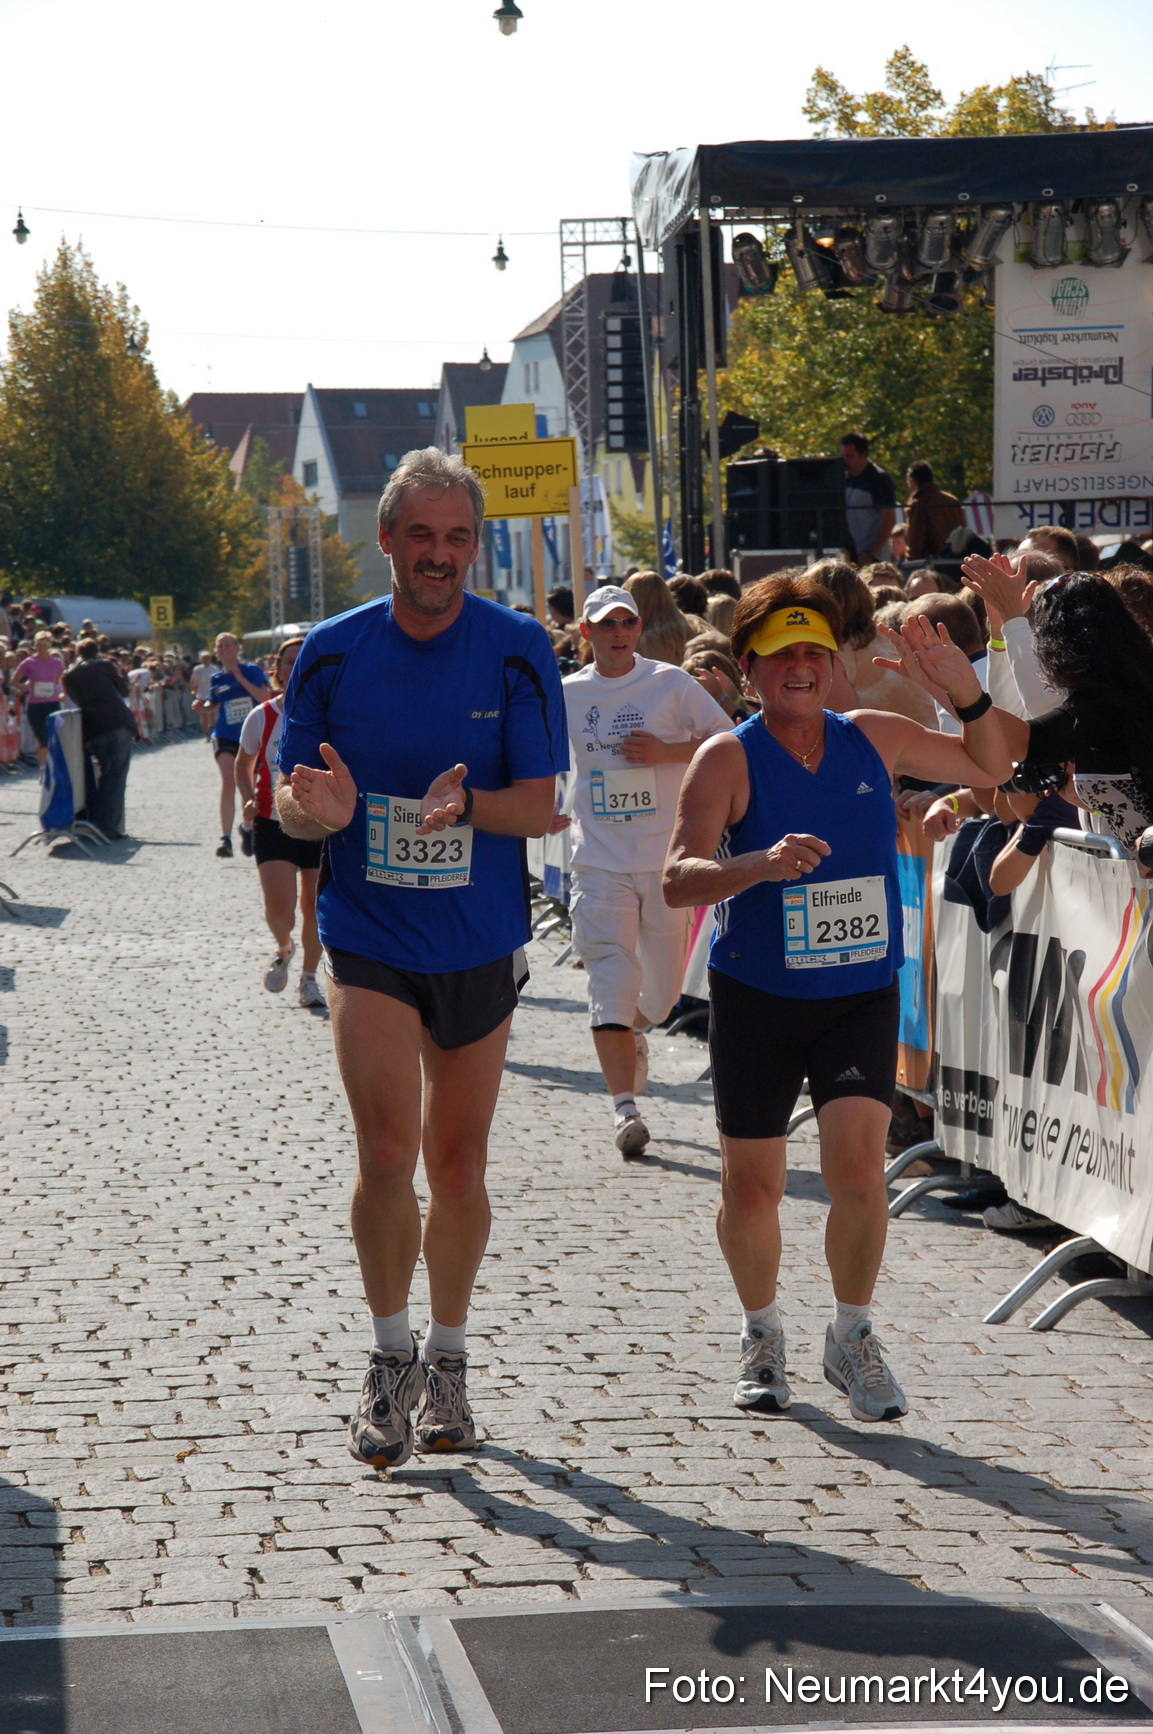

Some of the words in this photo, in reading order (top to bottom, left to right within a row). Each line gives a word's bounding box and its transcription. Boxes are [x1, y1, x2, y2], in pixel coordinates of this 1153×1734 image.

[1018, 333, 1060, 345] Tagblatt
[1061, 331, 1119, 343] Neumarkter
[1013, 356, 1124, 387] Pröbster
[1011, 442, 1123, 466] FISCHER
[470, 463, 569, 481] Schnupper-
[504, 482, 536, 499] lauf
[156, 605, 168, 622] B
[586, 742, 599, 752] 8.
[608, 791, 652, 809] 3718
[370, 828, 377, 841] D
[395, 837, 464, 864] 3323
[429, 873, 468, 883] PFLEIDERER
[812, 887, 862, 908] Elfriede
[788, 917, 796, 930] C
[816, 914, 880, 944] 2382
[786, 954, 827, 966] BOCK
[850, 945, 887, 959] PFLEIDERER
